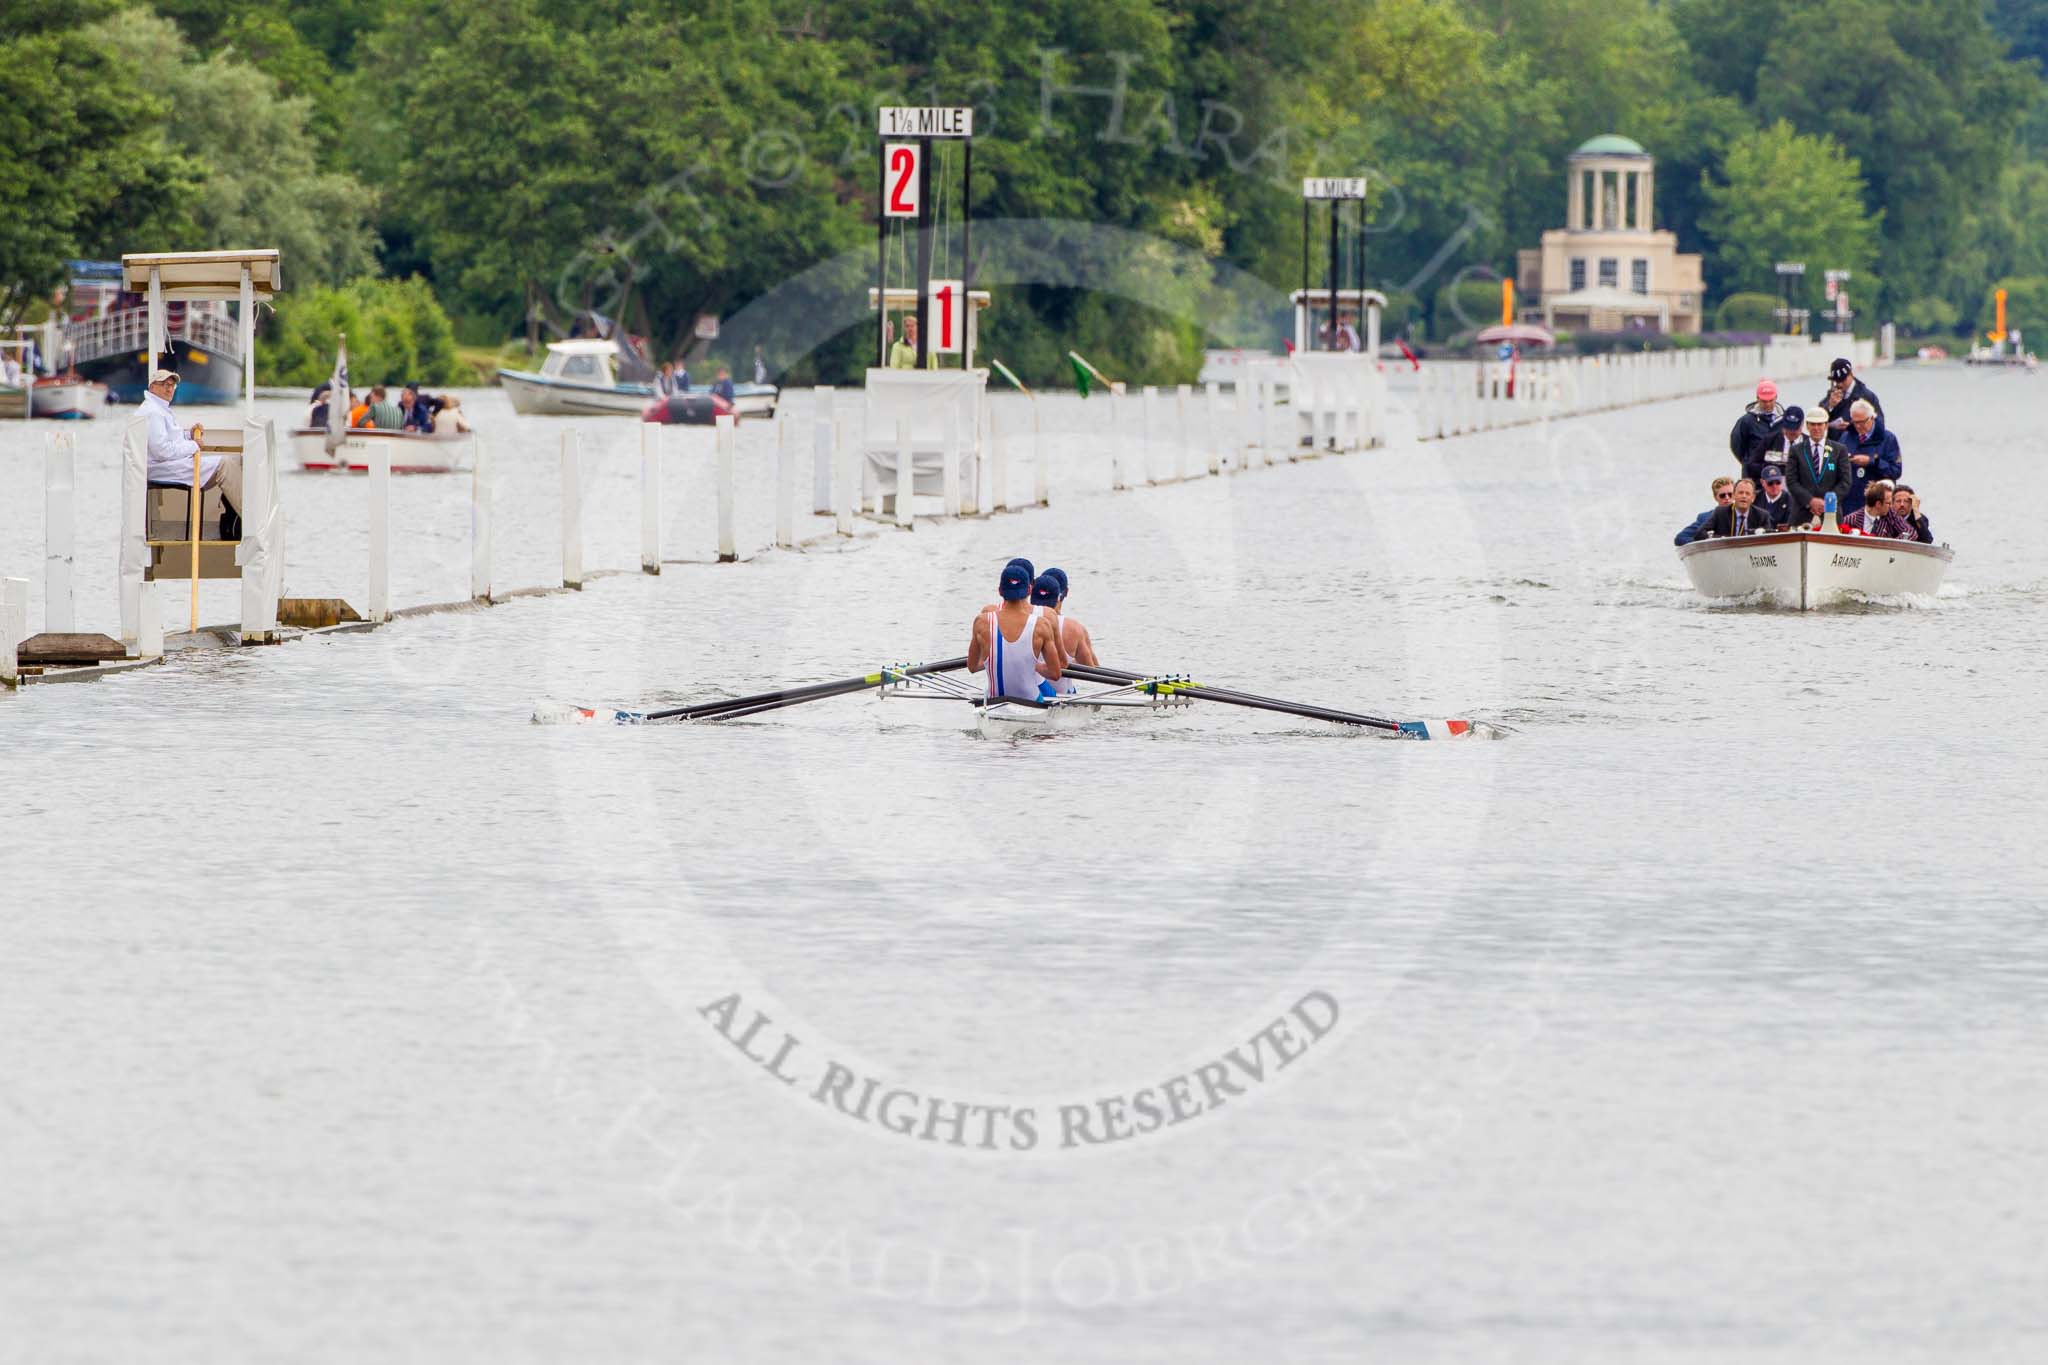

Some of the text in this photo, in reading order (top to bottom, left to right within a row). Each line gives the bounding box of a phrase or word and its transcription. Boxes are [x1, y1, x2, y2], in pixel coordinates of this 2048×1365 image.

[919, 108, 964, 133] MILE
[890, 148, 914, 212] 2
[1323, 179, 1360, 197] MILE
[936, 286, 952, 349] 1
[1749, 553, 1778, 568] ARIADNE
[1831, 552, 1862, 569] ARIADNE
